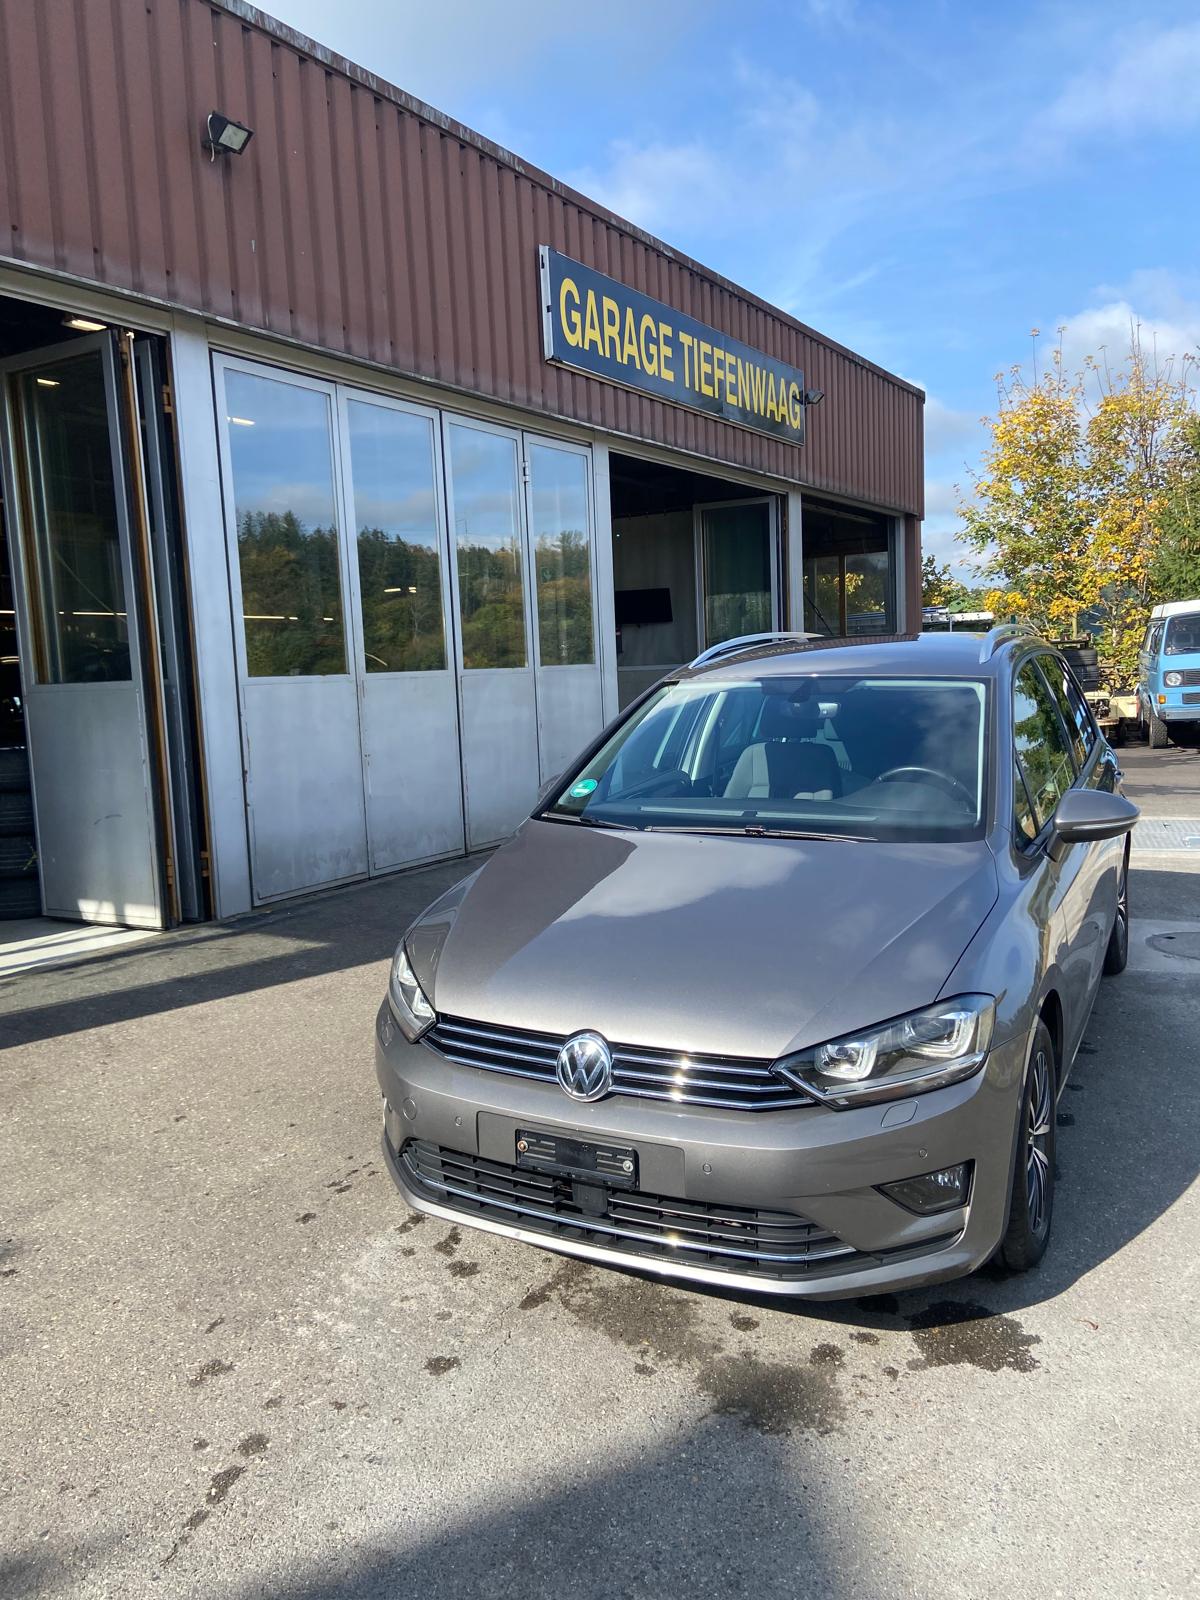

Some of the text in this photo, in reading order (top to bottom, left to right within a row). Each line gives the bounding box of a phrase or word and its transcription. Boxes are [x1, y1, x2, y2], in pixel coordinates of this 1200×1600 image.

[560, 278, 801, 430] GARAGE TIEFENWAAG
[559, 1037, 608, 1099] VW
